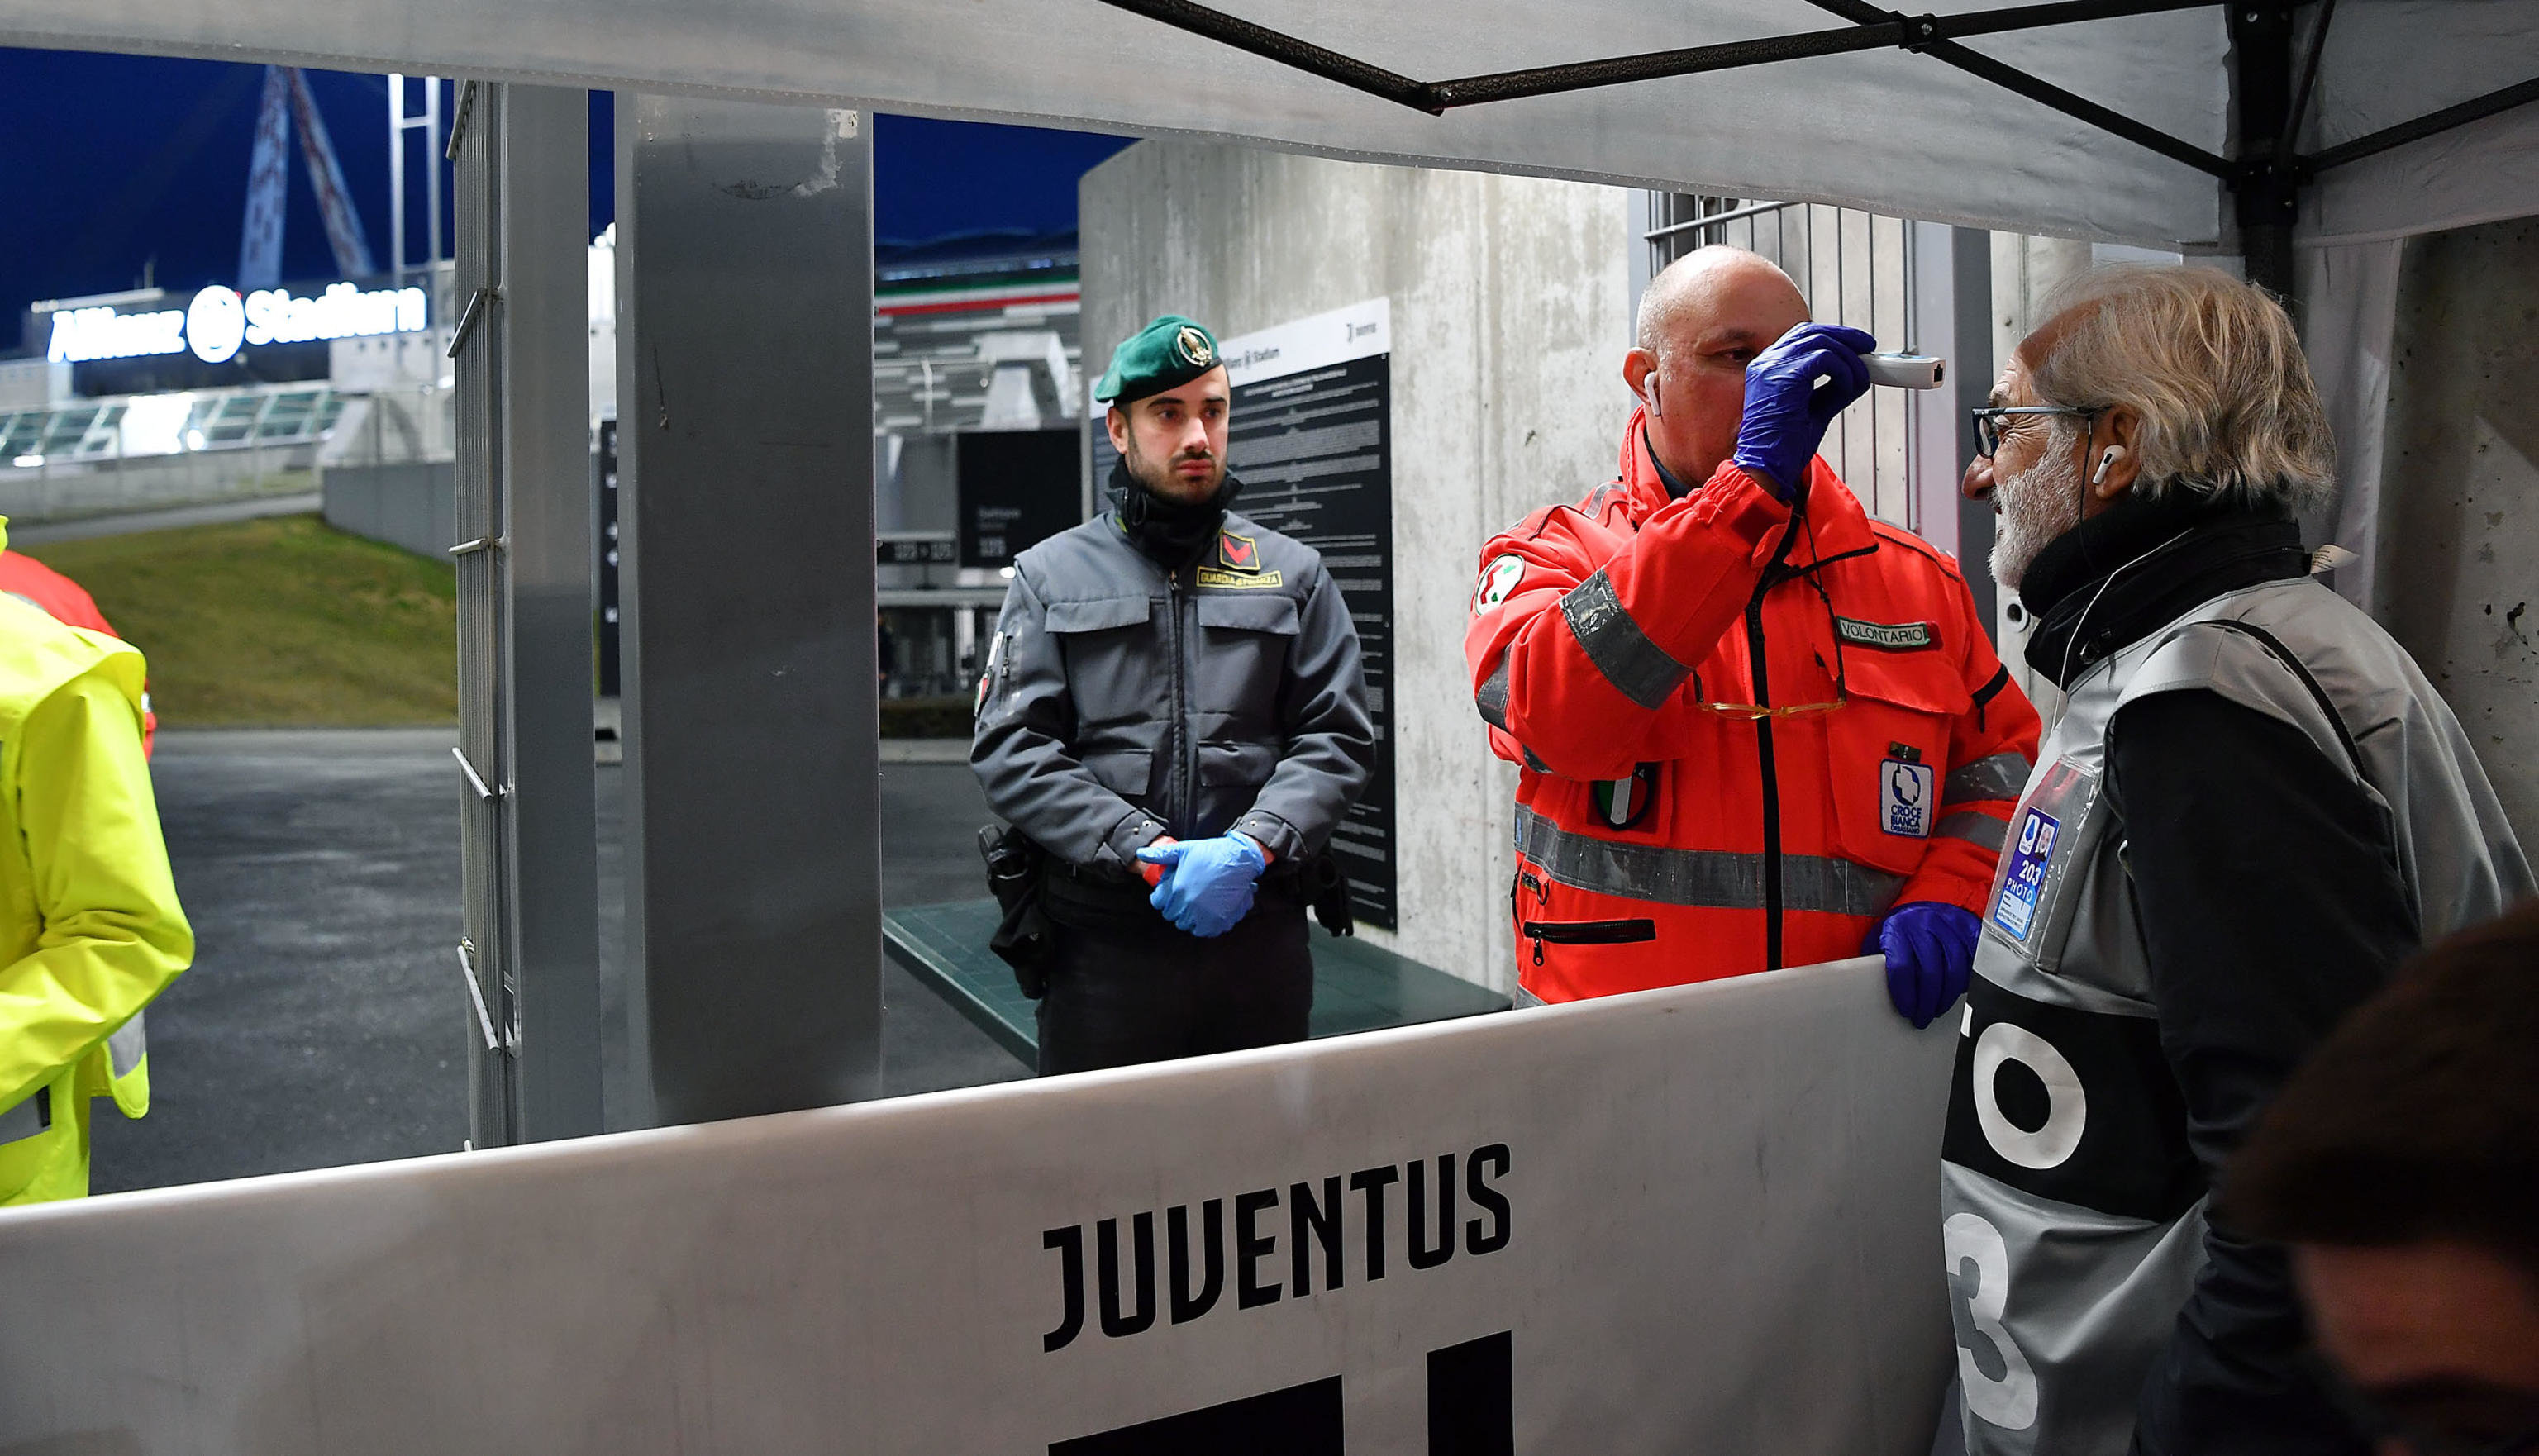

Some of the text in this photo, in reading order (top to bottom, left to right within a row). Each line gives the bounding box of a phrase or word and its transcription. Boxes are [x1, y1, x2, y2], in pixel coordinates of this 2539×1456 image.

[245, 282, 426, 345] Stadium
[1841, 621, 1923, 642] VOLONTARIO
[1891, 805, 1922, 819] CROCE
[1891, 815, 1921, 828] BIANCA
[2019, 860, 2041, 886] 203
[2006, 878, 2033, 902] PHOTO
[1960, 1002, 2087, 1170] O
[1043, 1143, 1512, 1353] JUVENTUS
